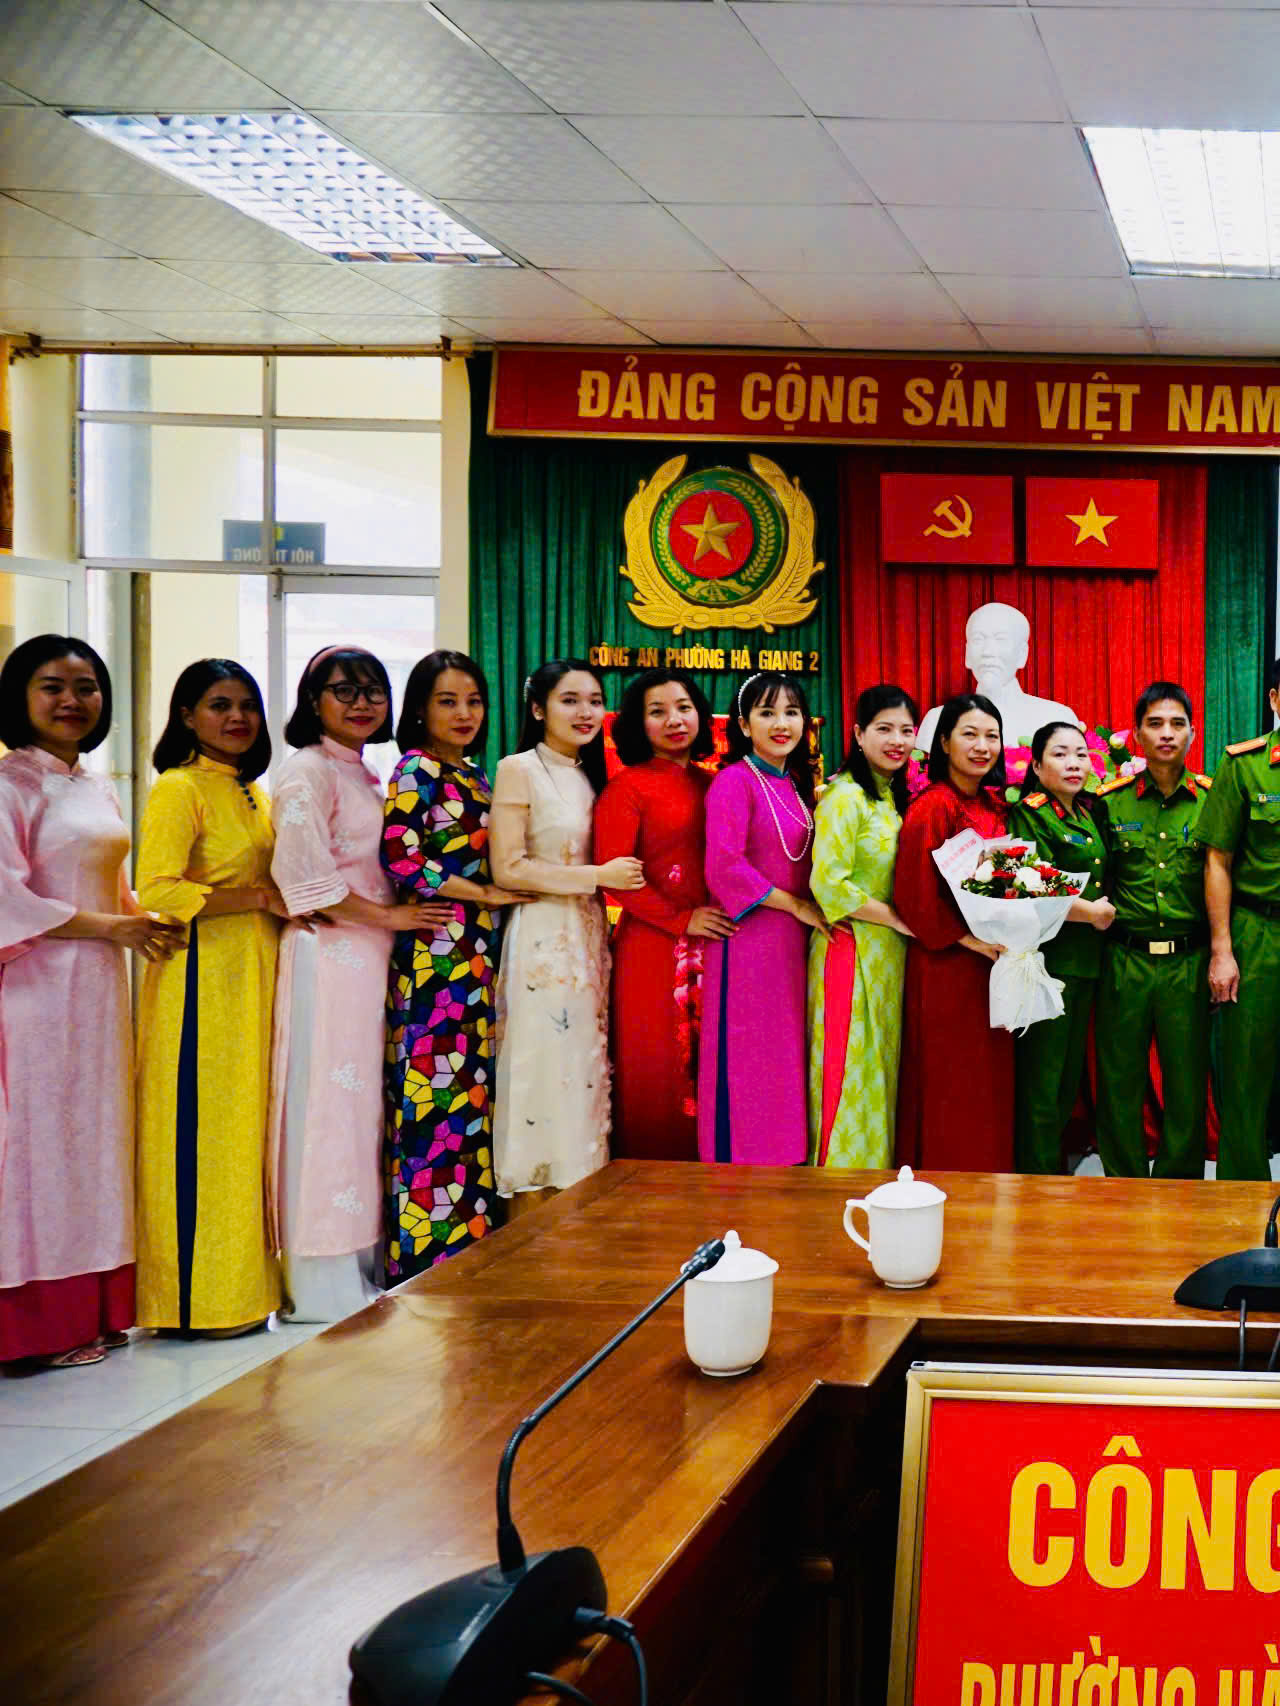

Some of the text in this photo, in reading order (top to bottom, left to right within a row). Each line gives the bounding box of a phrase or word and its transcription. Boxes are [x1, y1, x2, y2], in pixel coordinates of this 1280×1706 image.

[577, 355, 716, 421] ĐẢNG
[741, 363, 878, 432] CỘNG
[903, 363, 1007, 428] SẢN
[1036, 371, 1140, 440] VIỆT
[587, 641, 819, 671] CÔNG AN PHƯỜNG HÀ GIANG 2
